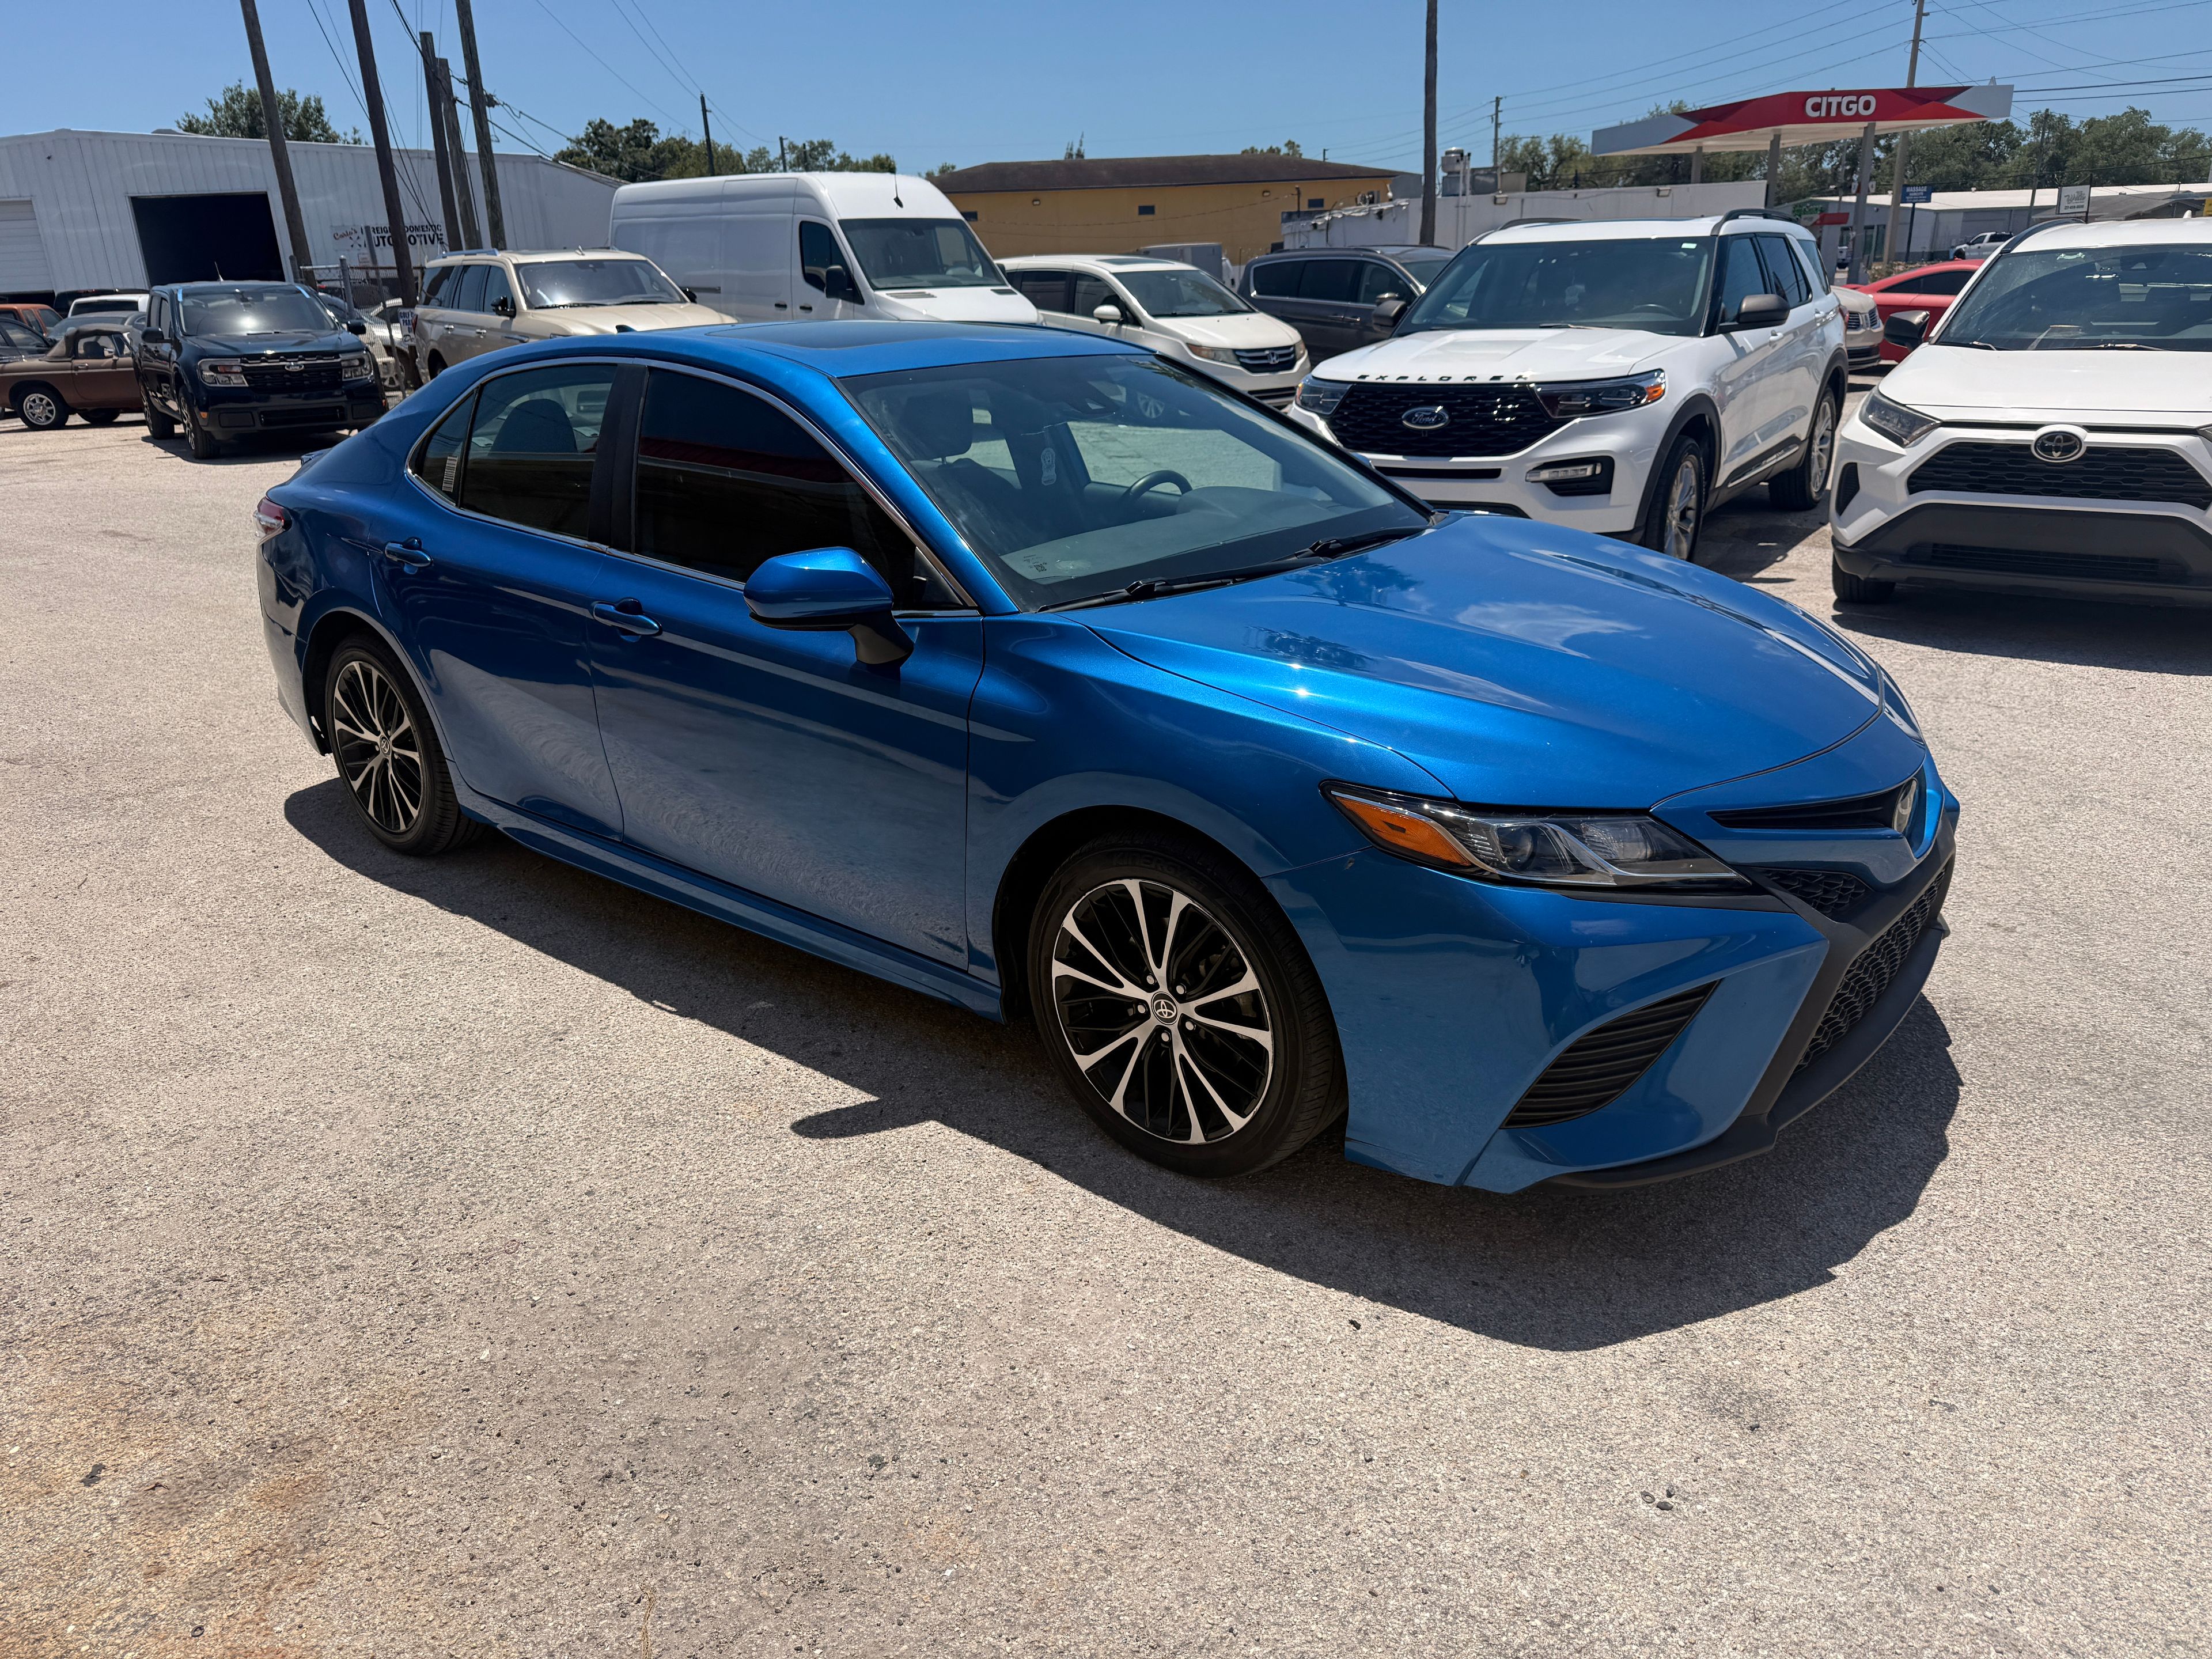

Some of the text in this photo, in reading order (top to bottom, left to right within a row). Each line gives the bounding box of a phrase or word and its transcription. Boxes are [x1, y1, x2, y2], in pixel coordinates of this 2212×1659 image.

[1805, 95, 1876, 117] CITGO
[361, 226, 391, 235] REIG
[364, 233, 443, 248] UTOOTIVE
[1357, 373, 1528, 381] EXPLORER
[1411, 411, 1437, 424] Ford
